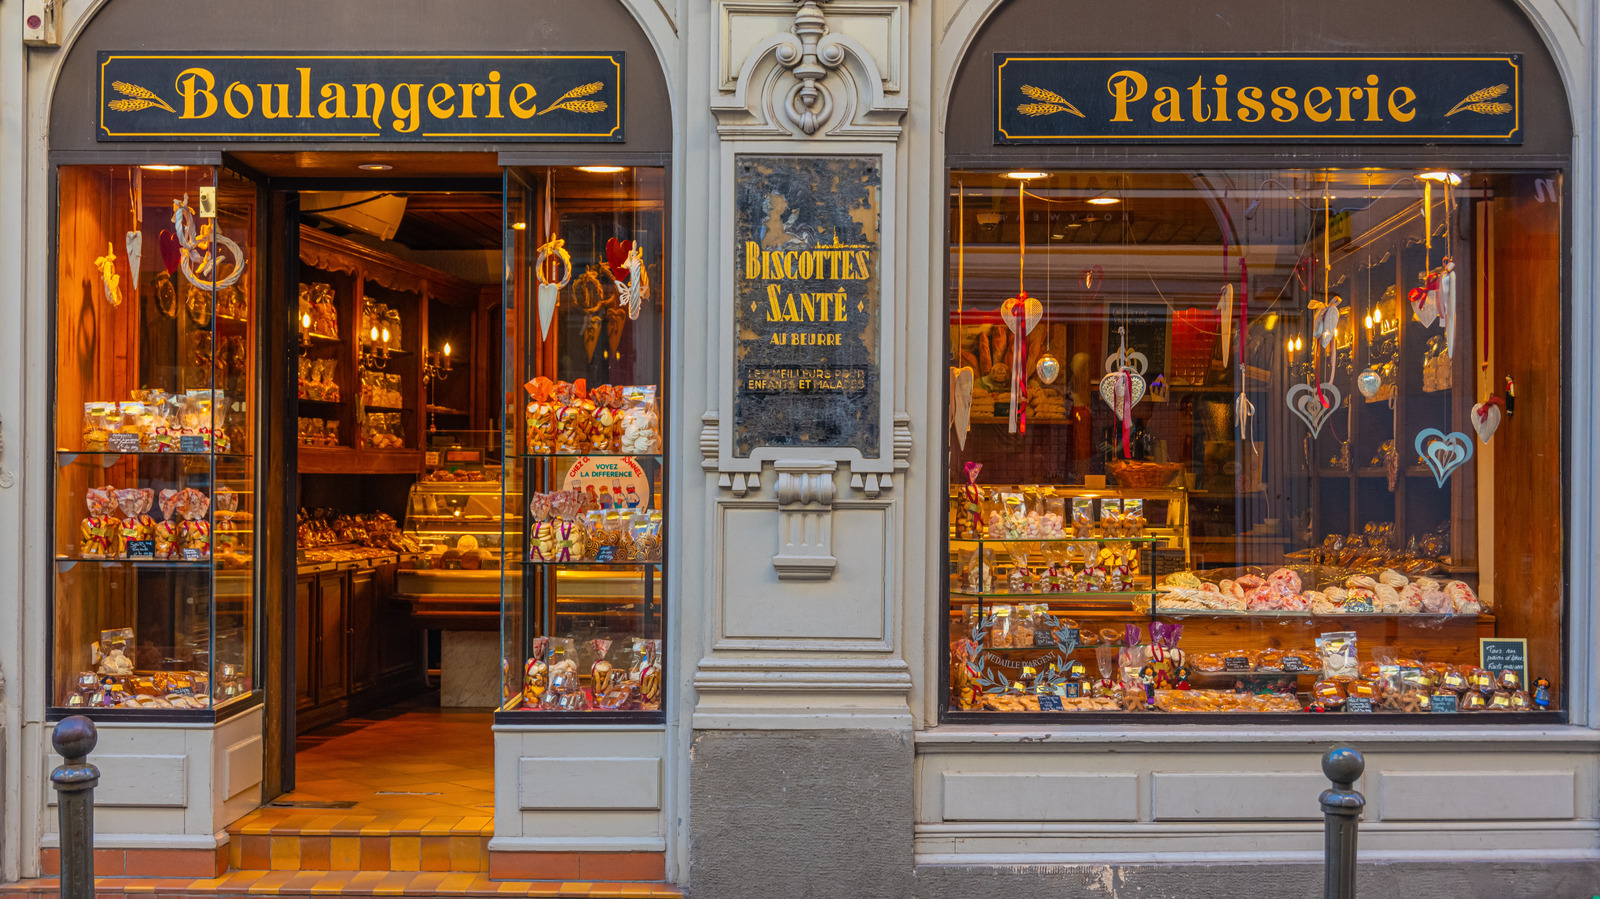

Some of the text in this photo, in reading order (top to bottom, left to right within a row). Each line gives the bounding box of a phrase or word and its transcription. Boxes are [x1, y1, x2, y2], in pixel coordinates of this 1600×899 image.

[175, 68, 538, 133] Boulangerie
[1107, 70, 1417, 123] Patisserie
[745, 241, 870, 280] BISCOTTES
[770, 333, 843, 346] AU BEURRE
[799, 379, 811, 389] ET
[569, 461, 584, 478] CHEZ
[985, 651, 1020, 669] MEDAILLE
